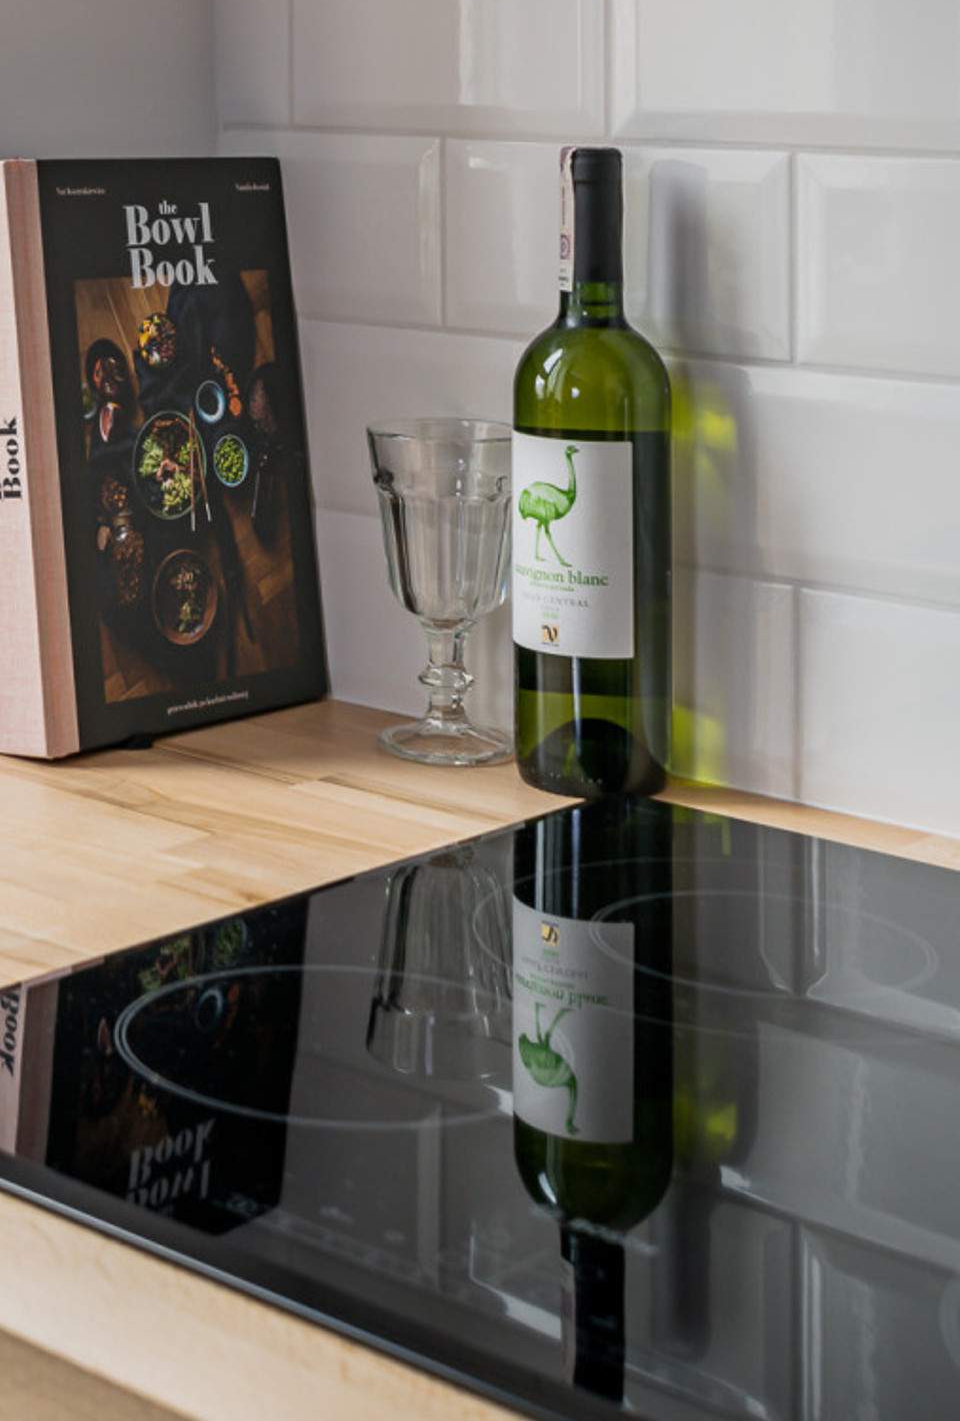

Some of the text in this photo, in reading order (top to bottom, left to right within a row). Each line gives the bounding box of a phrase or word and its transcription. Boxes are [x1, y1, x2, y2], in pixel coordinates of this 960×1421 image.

[123, 202, 215, 247] Bowl
[158, 200, 177, 216] the
[126, 244, 219, 290] Book
[0, 417, 22, 500] Book
[568, 570, 610, 587] blanc
